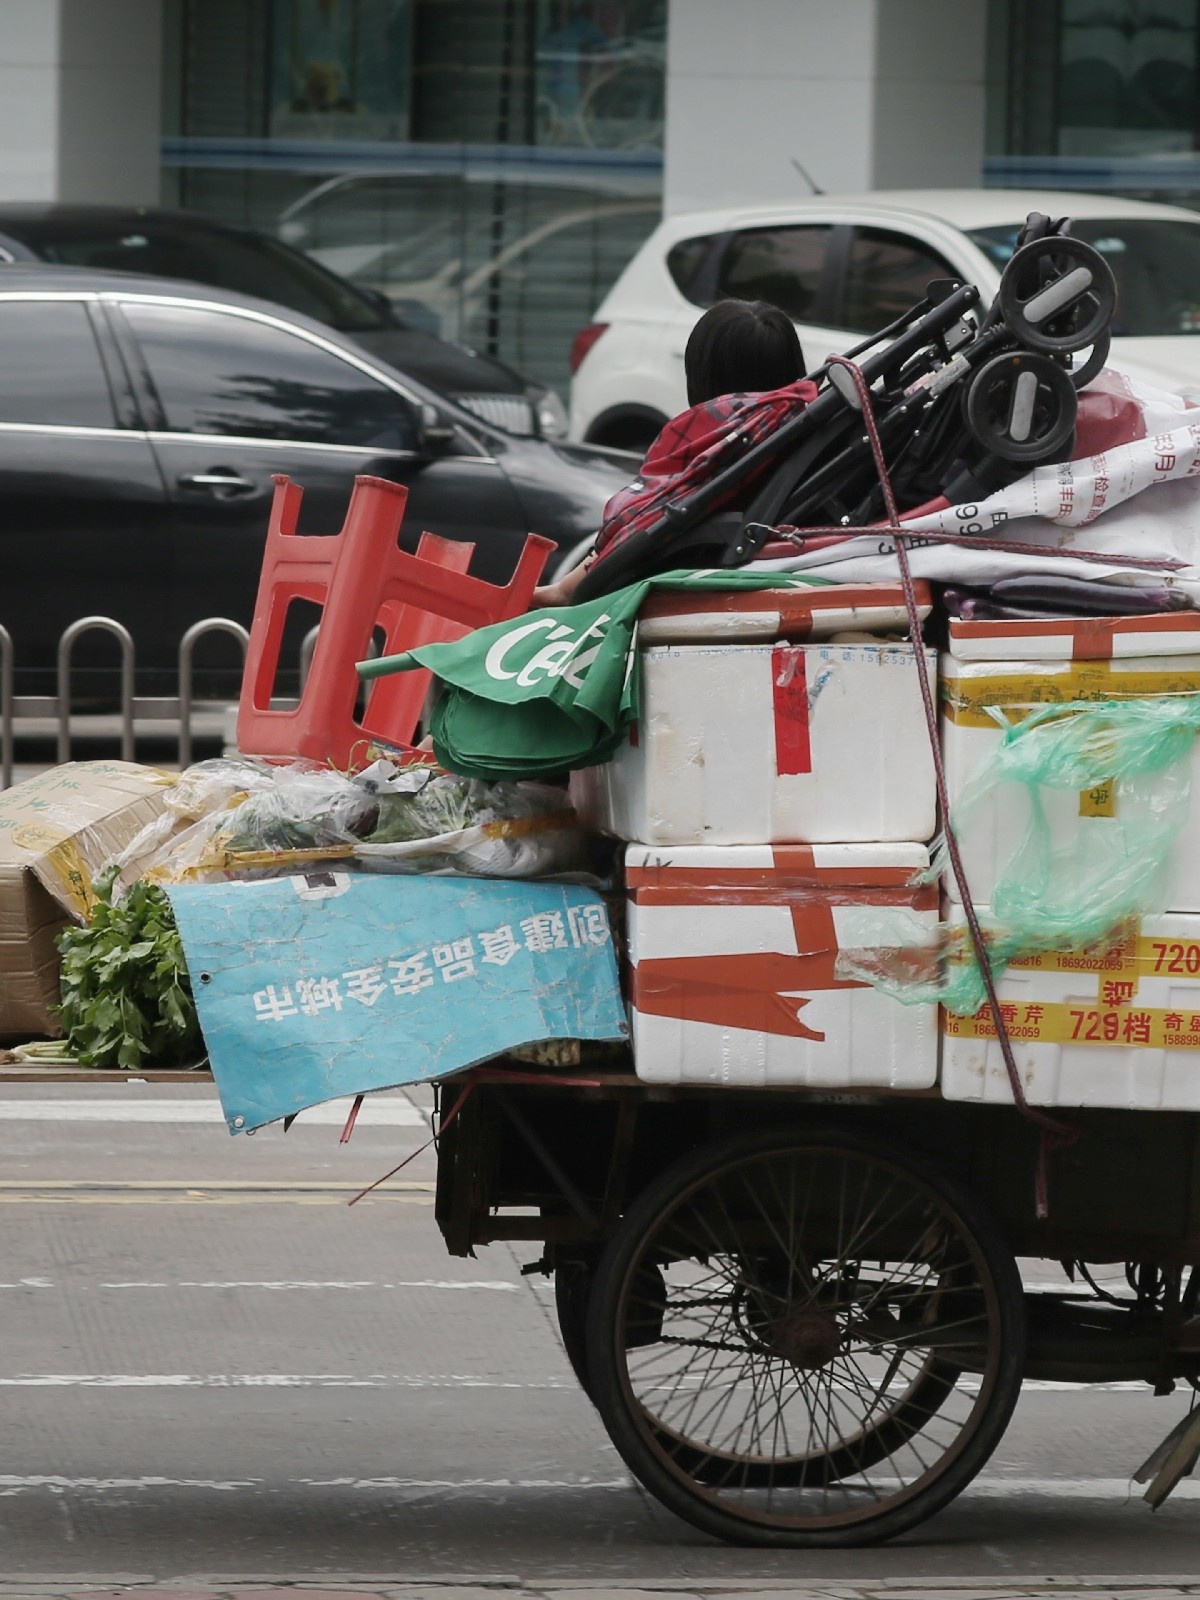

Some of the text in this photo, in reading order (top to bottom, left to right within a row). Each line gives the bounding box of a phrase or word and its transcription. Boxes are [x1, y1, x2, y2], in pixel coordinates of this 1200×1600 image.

[252, 904, 612, 1023] 创建食品安全城市
